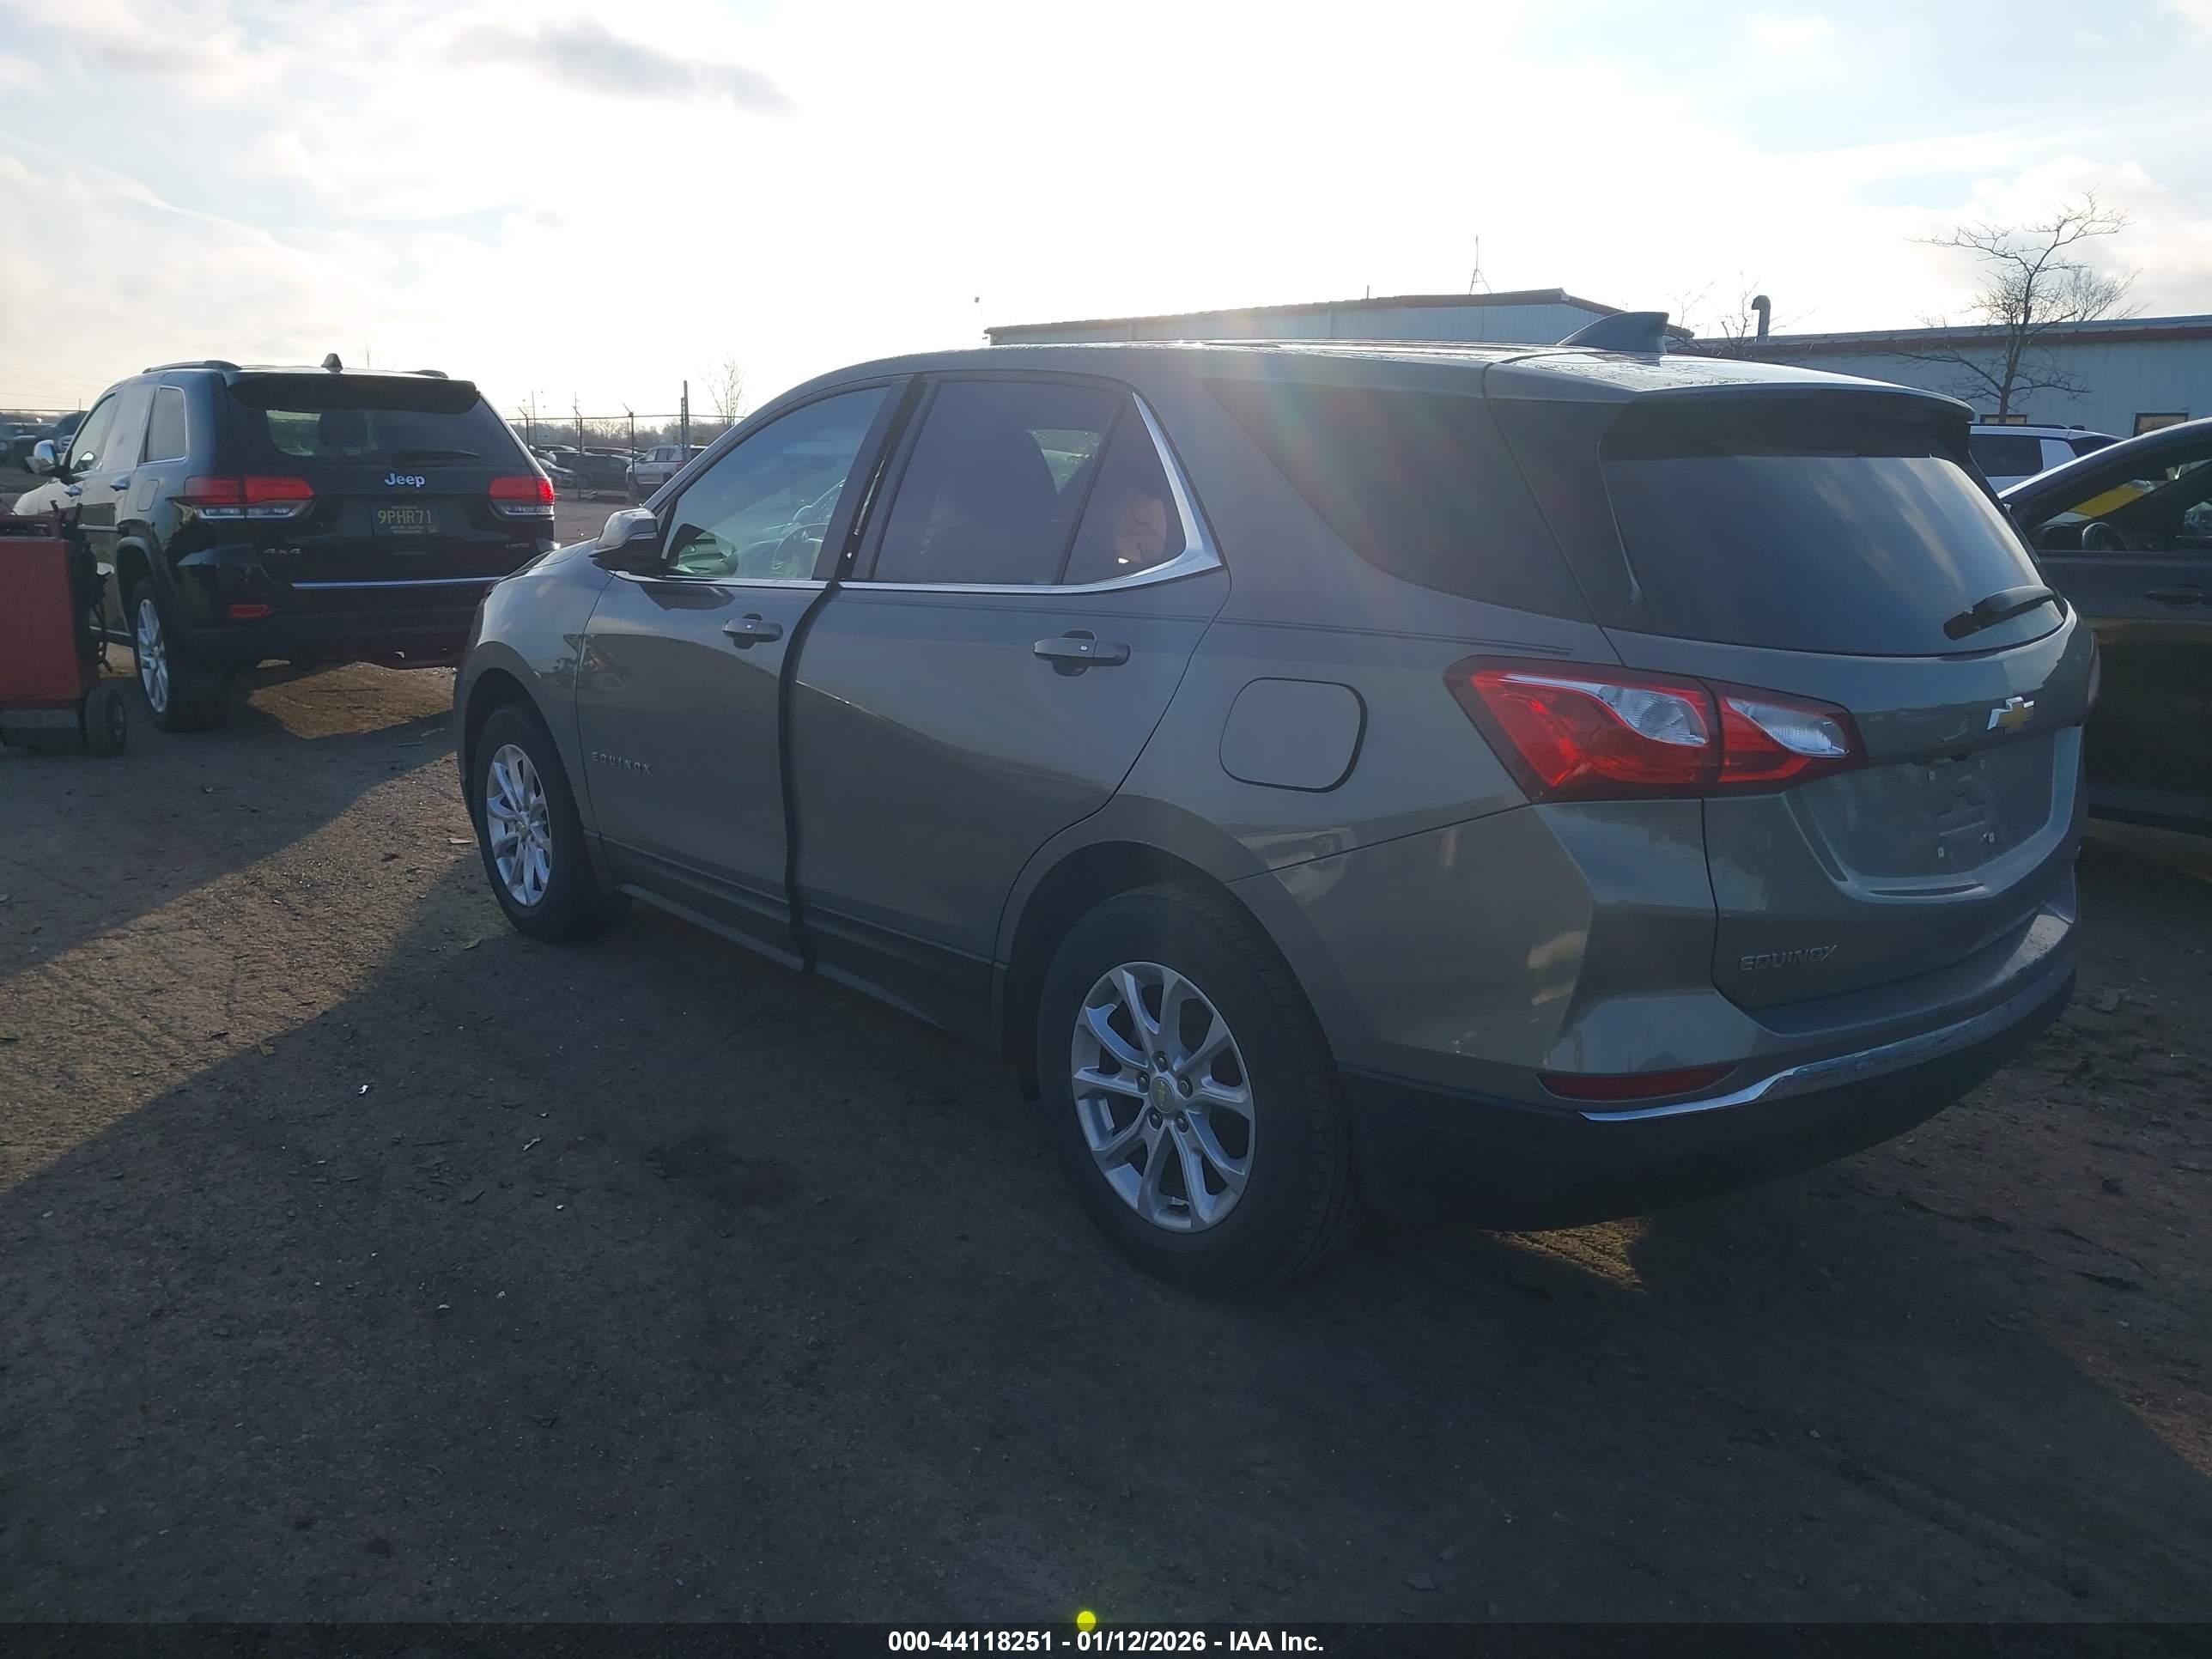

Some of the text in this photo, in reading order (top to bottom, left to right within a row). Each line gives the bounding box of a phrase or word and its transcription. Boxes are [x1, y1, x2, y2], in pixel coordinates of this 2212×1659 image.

[384, 472, 426, 488] Jeep
[378, 510, 433, 524] 9PHR71
[592, 751, 652, 775] EQUINOX
[1740, 945, 1838, 971] EQUINOX
